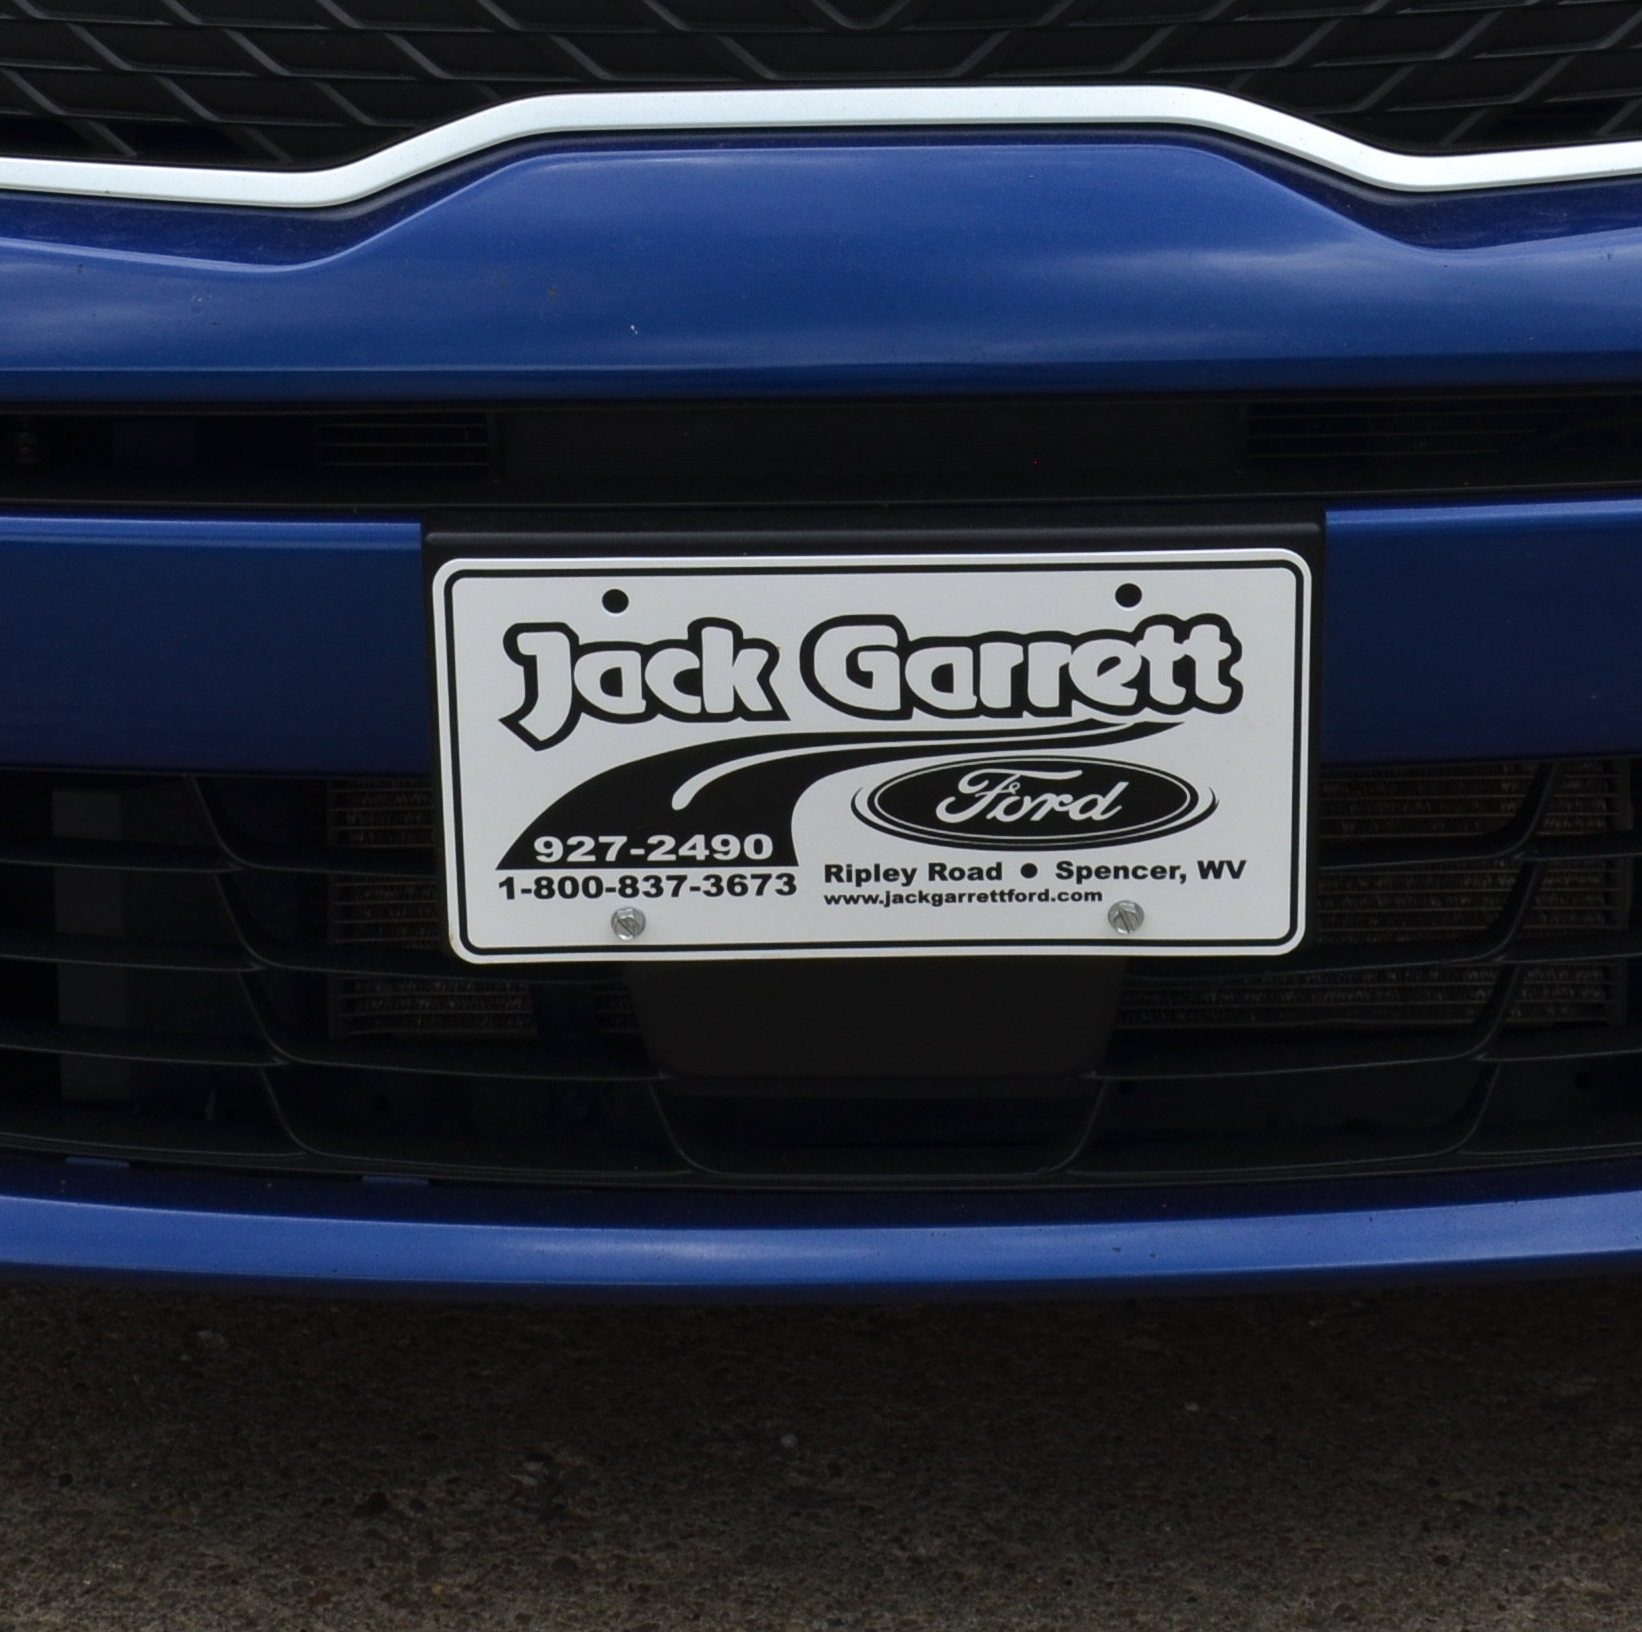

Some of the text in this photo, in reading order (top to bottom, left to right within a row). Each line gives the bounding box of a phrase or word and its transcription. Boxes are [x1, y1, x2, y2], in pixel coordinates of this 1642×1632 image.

[499, 612, 1245, 753] Jack Garrett
[935, 768, 1130, 824] Ford
[533, 832, 774, 864] 927-2490
[497, 871, 798, 901] 1-800-837-3673
[823, 858, 1248, 888] Ripley Road Spencer, WV
[822, 886, 1104, 908] www.jackgarrettford.com
